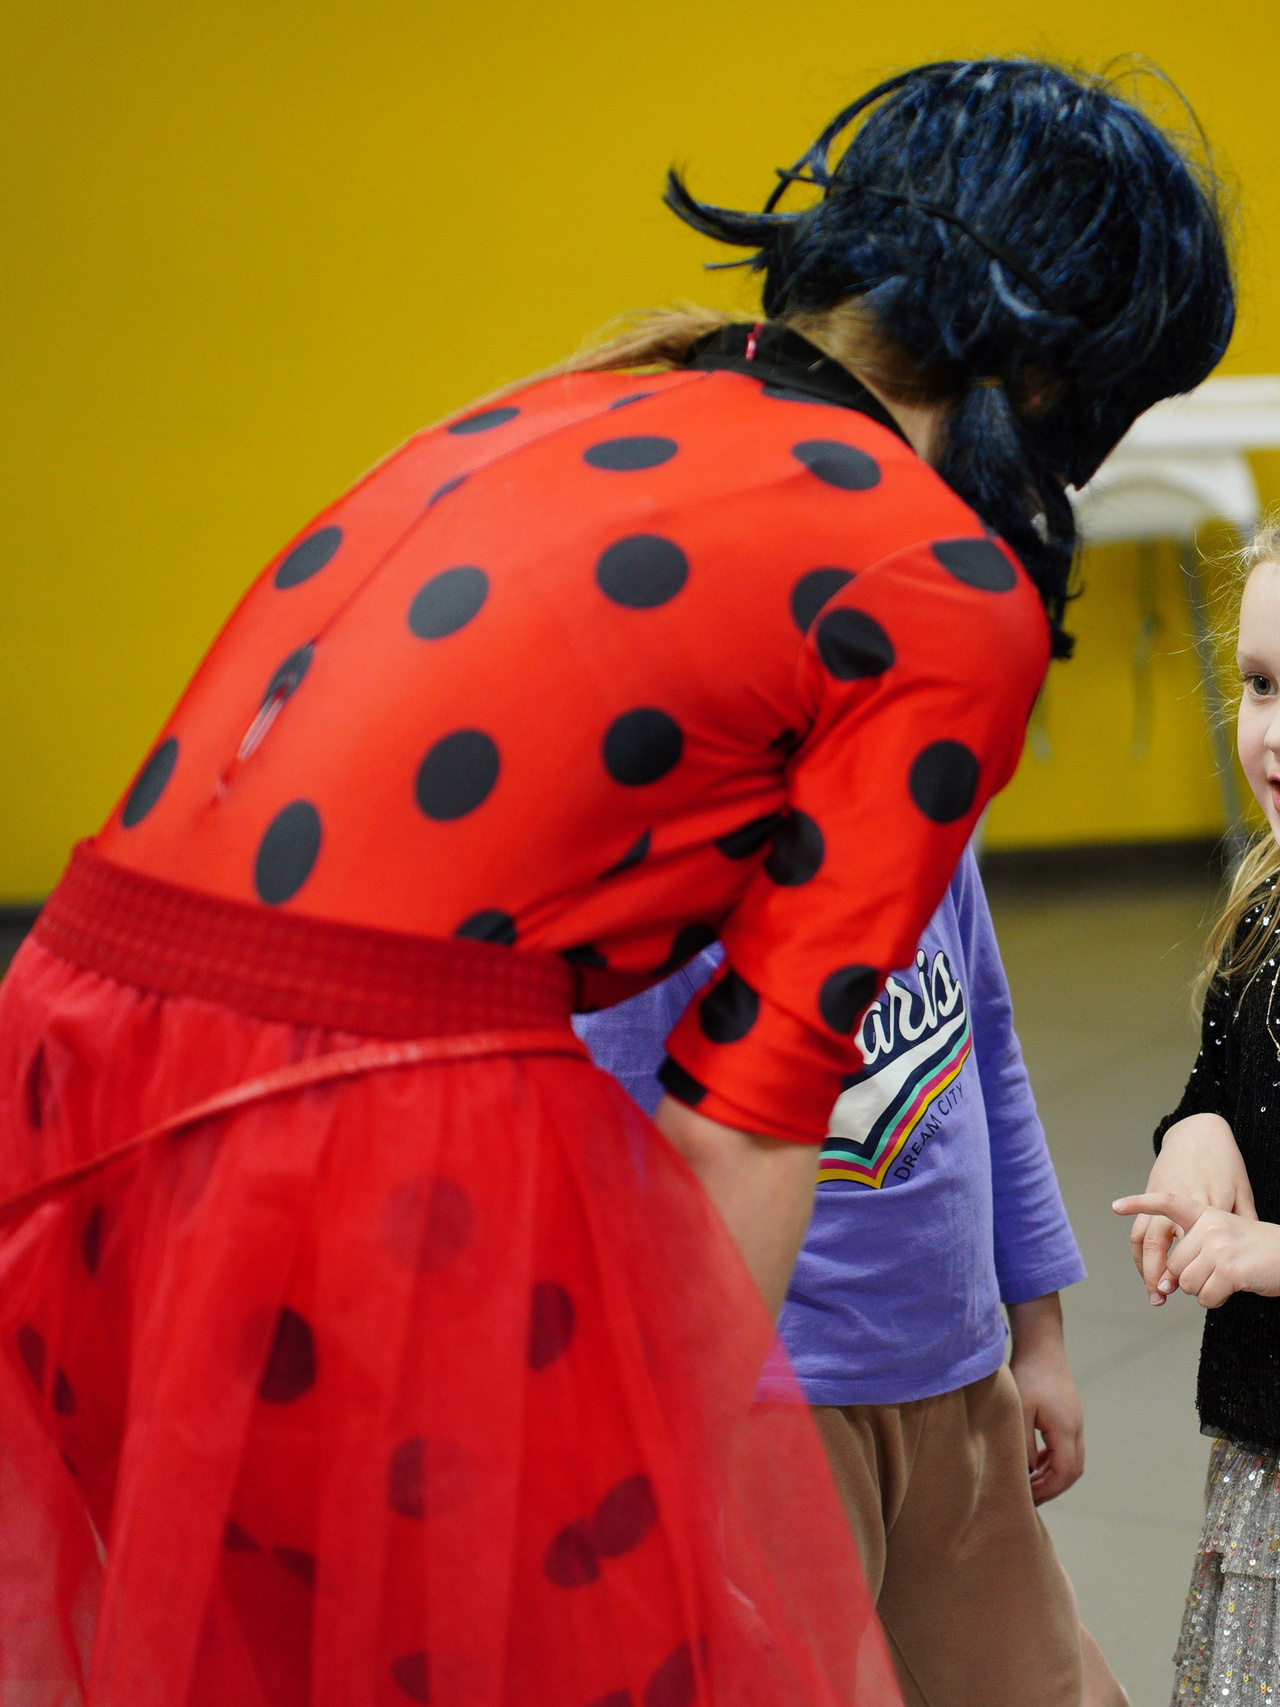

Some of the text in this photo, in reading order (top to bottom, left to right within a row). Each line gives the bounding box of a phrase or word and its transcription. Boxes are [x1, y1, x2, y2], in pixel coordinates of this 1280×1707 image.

[854, 948, 967, 1066] aris
[893, 1081, 964, 1181] DREAM CITY
